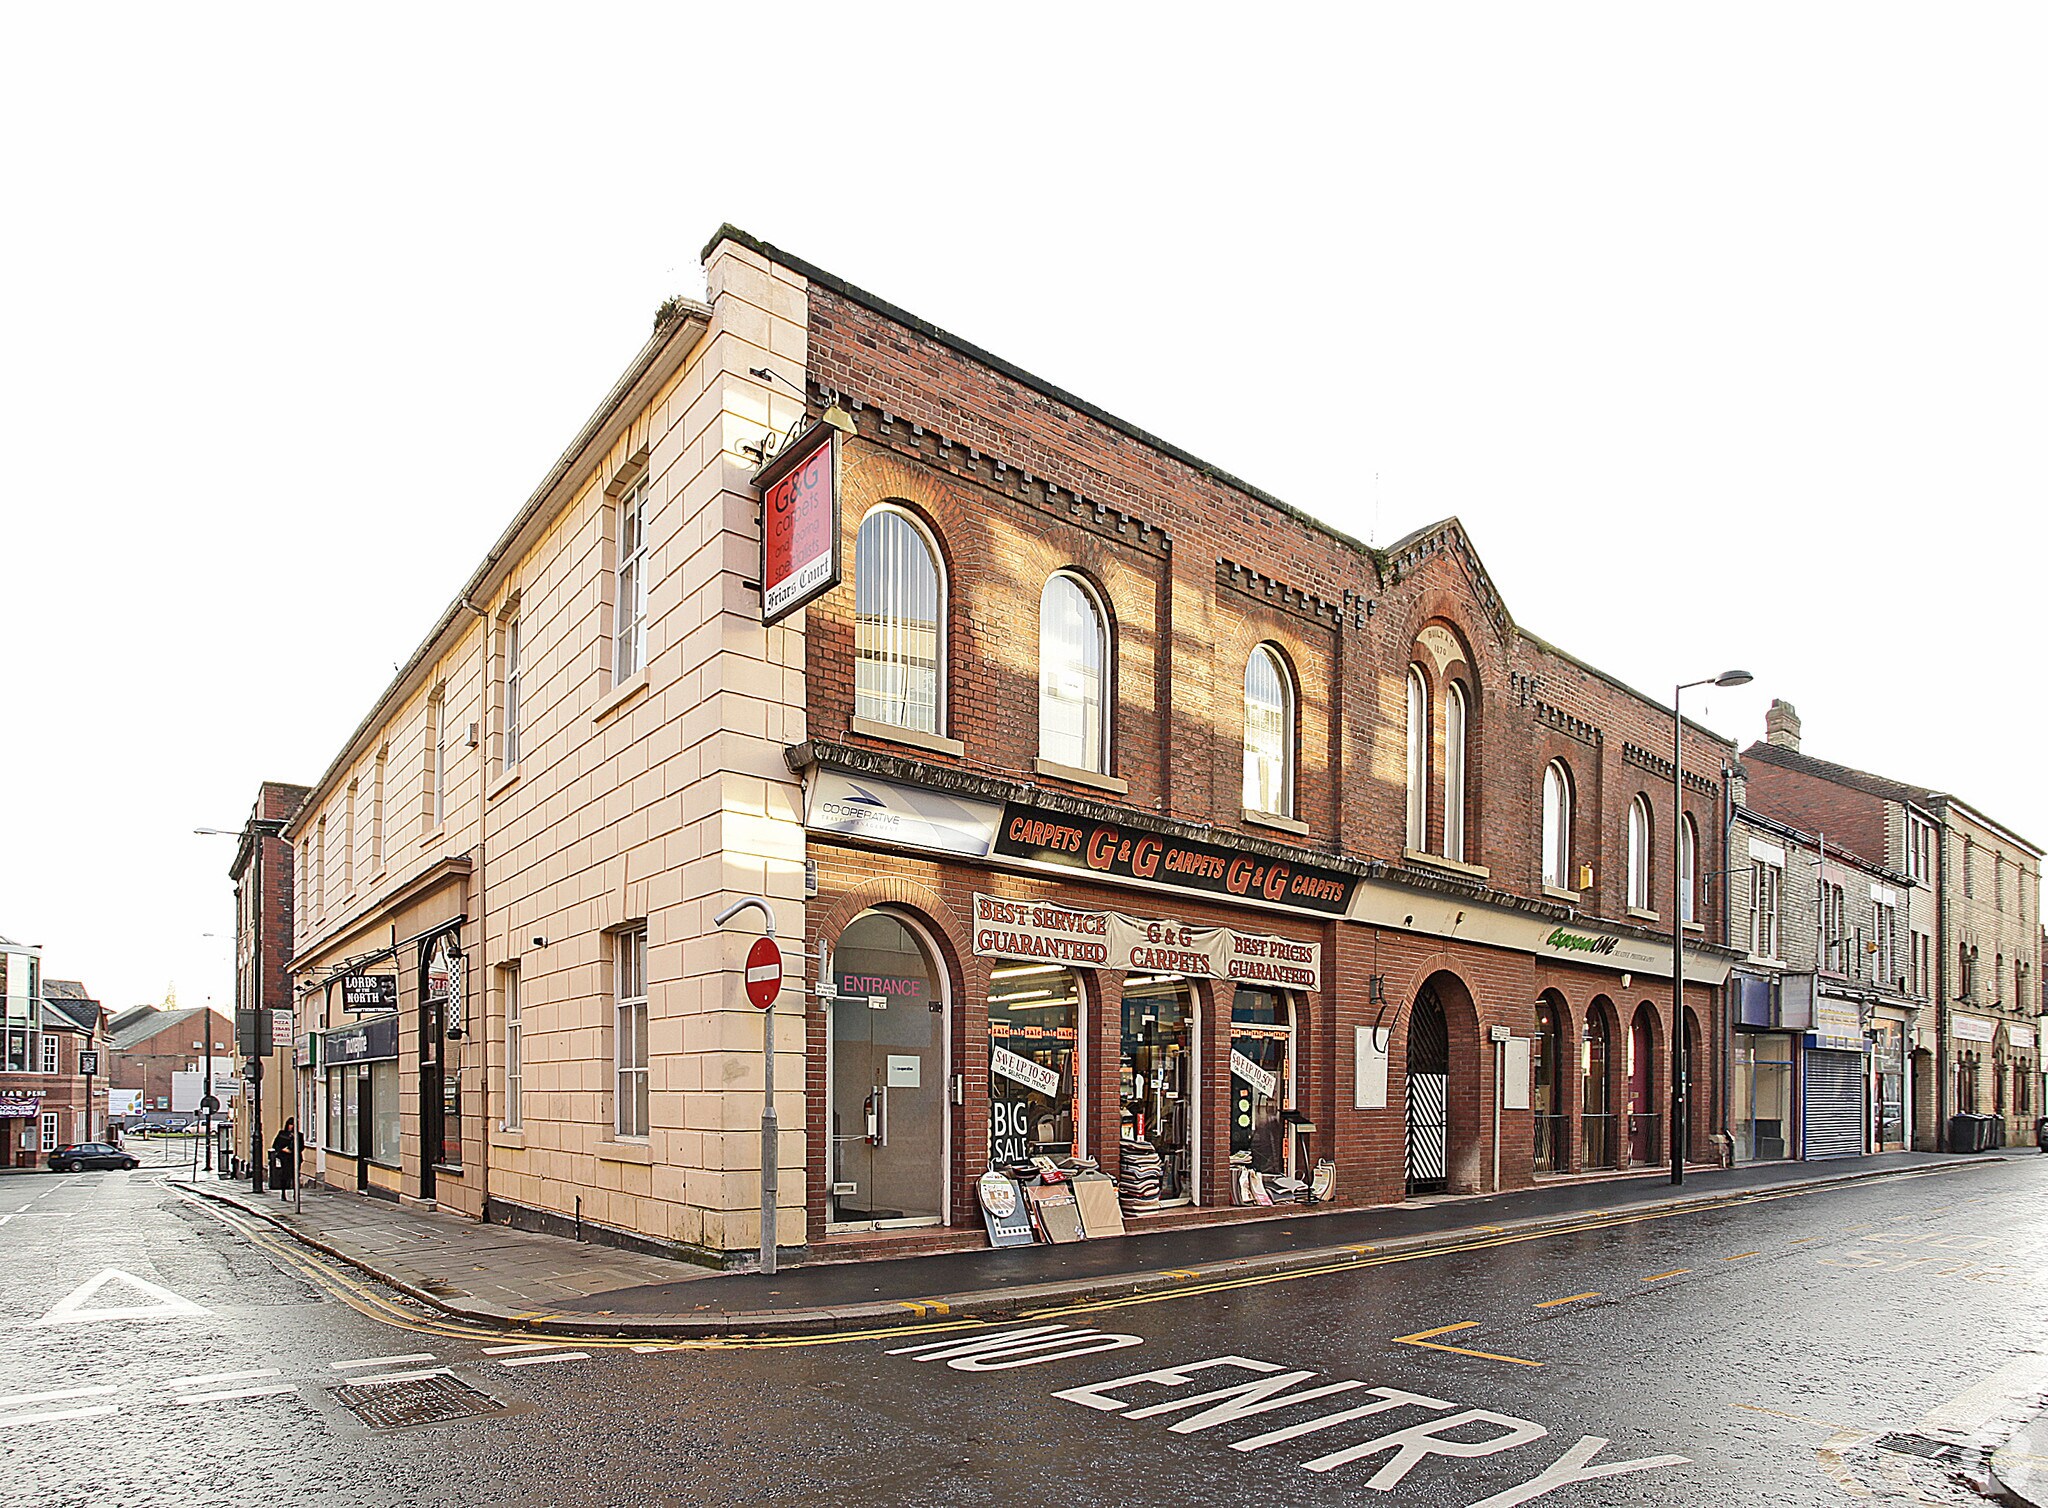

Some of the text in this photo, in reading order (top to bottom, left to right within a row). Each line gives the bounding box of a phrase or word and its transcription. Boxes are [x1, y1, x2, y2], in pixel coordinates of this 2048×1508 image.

[775, 456, 818, 513] G&G
[776, 492, 818, 536] carpets
[775, 539, 819, 580] specialists
[776, 540, 789, 558] and
[767, 557, 829, 611] Friars Court
[1428, 630, 1443, 639] BUILT
[1434, 644, 1447, 656] 1870
[1009, 817, 1082, 852] CARPETS
[1165, 849, 1225, 879] CARPETS
[1291, 875, 1345, 902] CARPETS
[979, 899, 1107, 935] BEST SERVICE
[978, 929, 1108, 963] GUARANTEED
[1130, 946, 1210, 974] CARPETS
[1234, 936, 1313, 964] BEST PRICES
[345, 977, 377, 988] LORDS
[844, 975, 920, 996] ENTRANCE
[1227, 959, 1316, 986] GUARANTEED
[347, 993, 379, 1003] NORTH
[996, 1050, 1057, 1087] SAVE UP TO 50%
[1008, 1068, 1030, 1083] SELECTED
[1031, 1079, 1046, 1090] ITEMS
[1254, 1068, 1261, 1080] TO
[994, 1102, 1028, 1137] BIG
[995, 1138, 1028, 1163] SALE
[884, 1324, 1694, 1508] NO ENTRY
